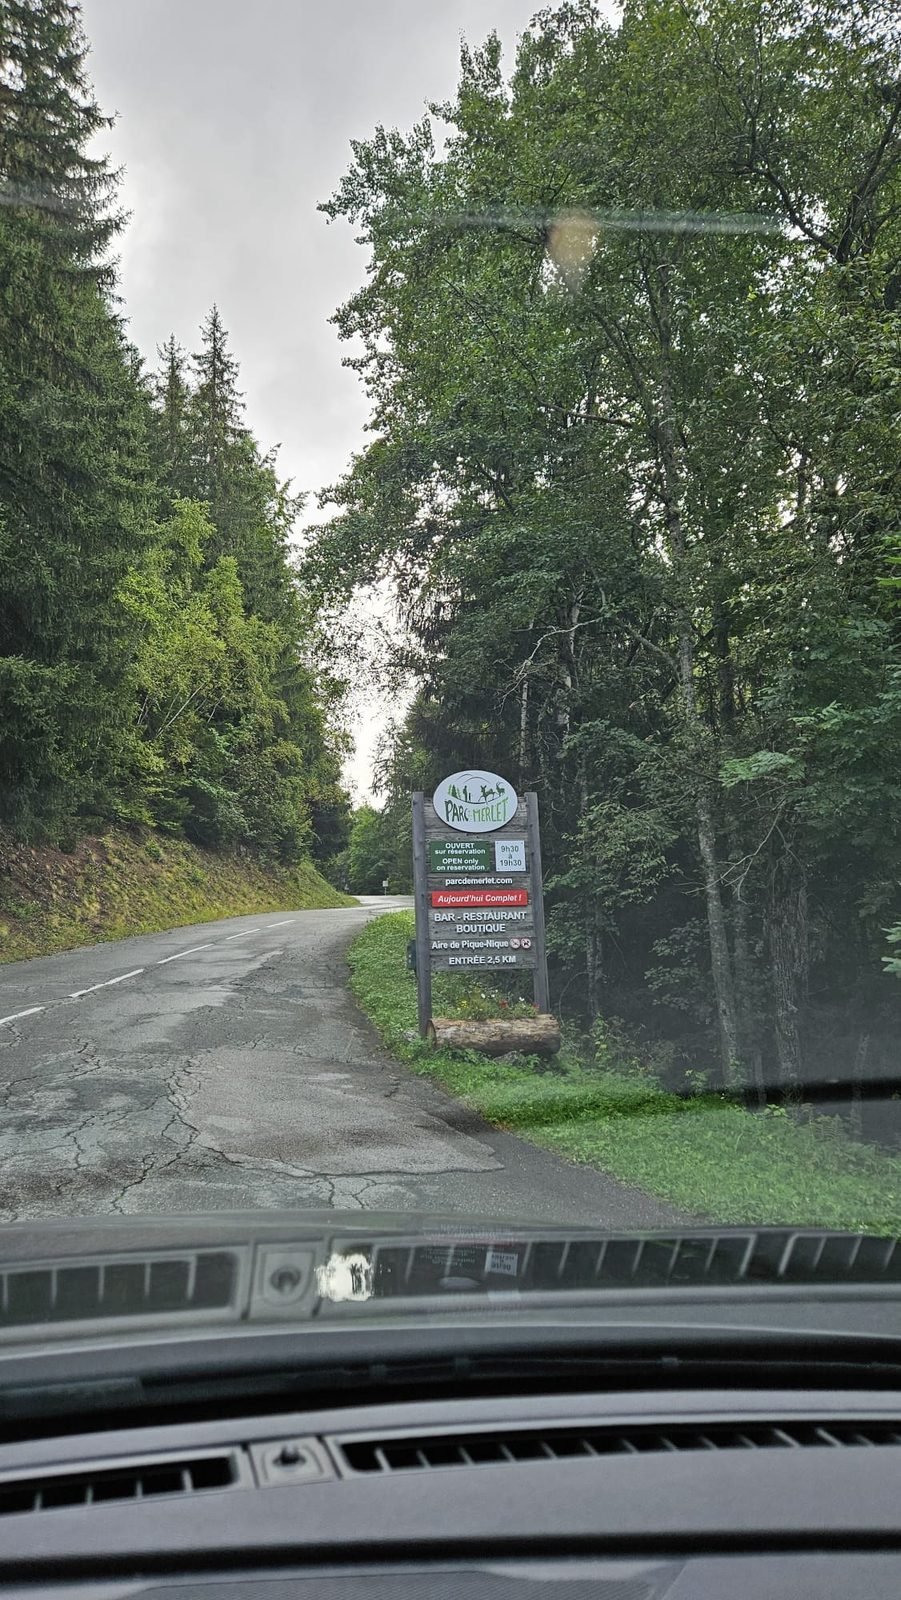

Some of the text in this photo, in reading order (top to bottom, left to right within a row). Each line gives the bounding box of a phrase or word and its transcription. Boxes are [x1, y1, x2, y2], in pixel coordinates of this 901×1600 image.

[444, 799, 469, 822] PARC
[473, 798, 509, 822] MERLET
[464, 858, 479, 866] only
[445, 877, 513, 886] parcdemerlet.com
[437, 895, 484, 903] Aujourd'hui
[485, 894, 517, 902] Complet
[434, 913, 455, 922] BAR
[463, 912, 526, 921] RESTAURANT
[456, 924, 506, 933] BOUTIQUE
[432, 941, 447, 949] Aire
[462, 939, 509, 949] Pique-Nique
[449, 955, 485, 965] ENTRÉE
[488, 956, 500, 964] 2,5
